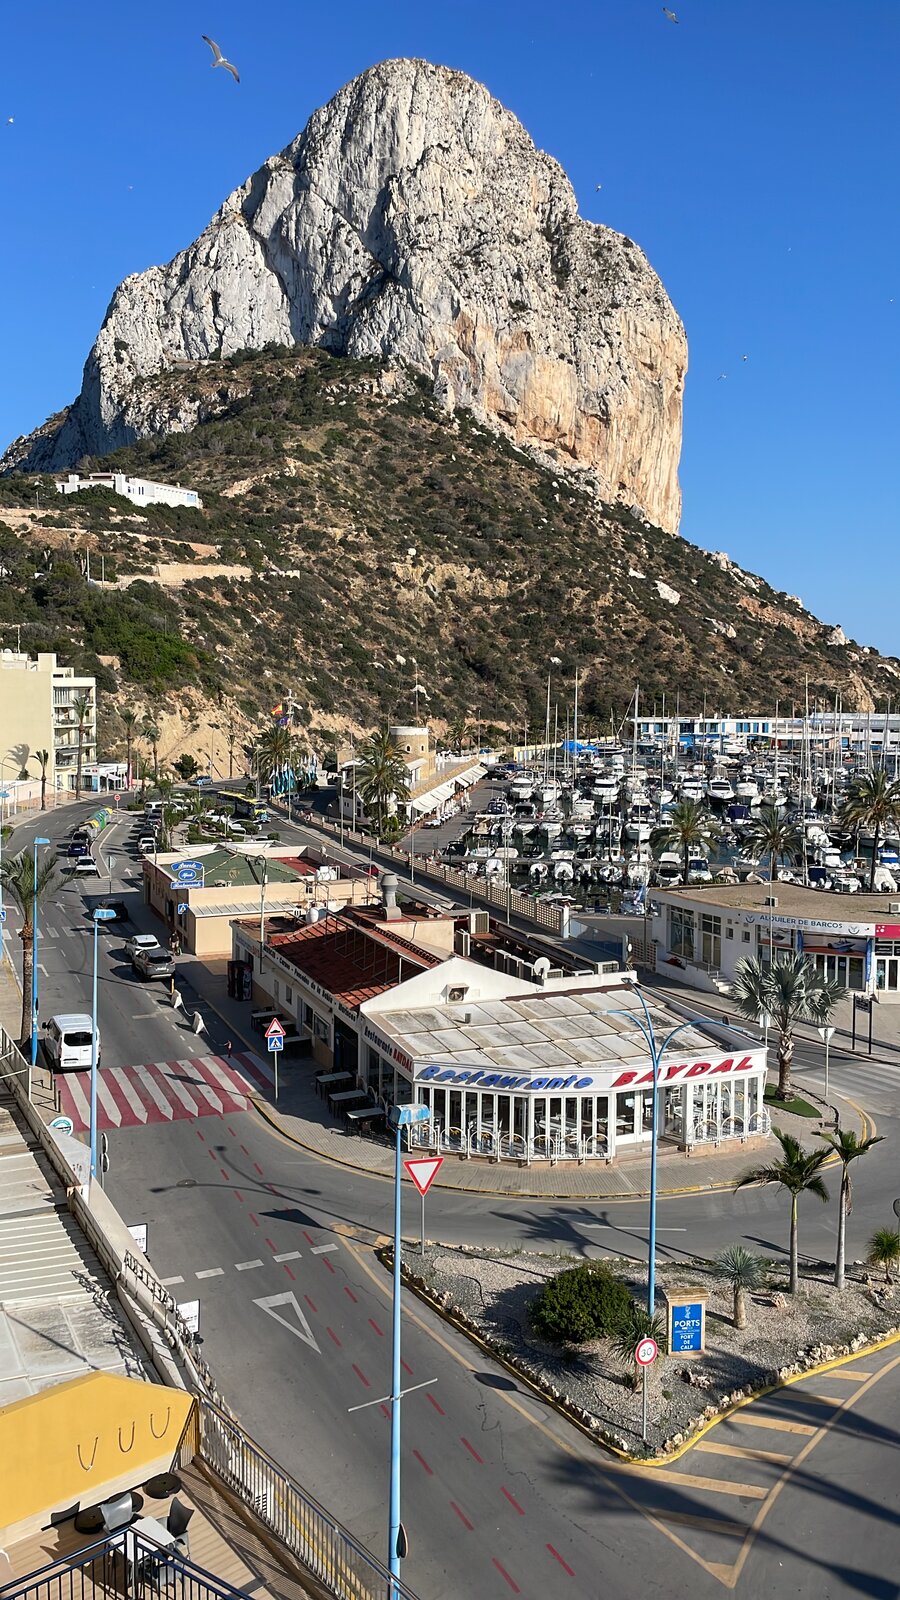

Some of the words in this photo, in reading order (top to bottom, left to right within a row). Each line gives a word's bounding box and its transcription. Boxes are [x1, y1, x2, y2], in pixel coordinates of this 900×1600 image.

[759, 914, 797, 925] ALQUILER
[810, 920, 844, 929] BARCOS
[364, 1025, 393, 1057] Restaurante
[393, 1048, 413, 1073] BAYDAL
[415, 1064, 594, 1090] Restaurante
[609, 1056, 754, 1088] BAYDAL
[674, 1319, 701, 1328] PORTS
[640, 1346, 653, 1358] 30
